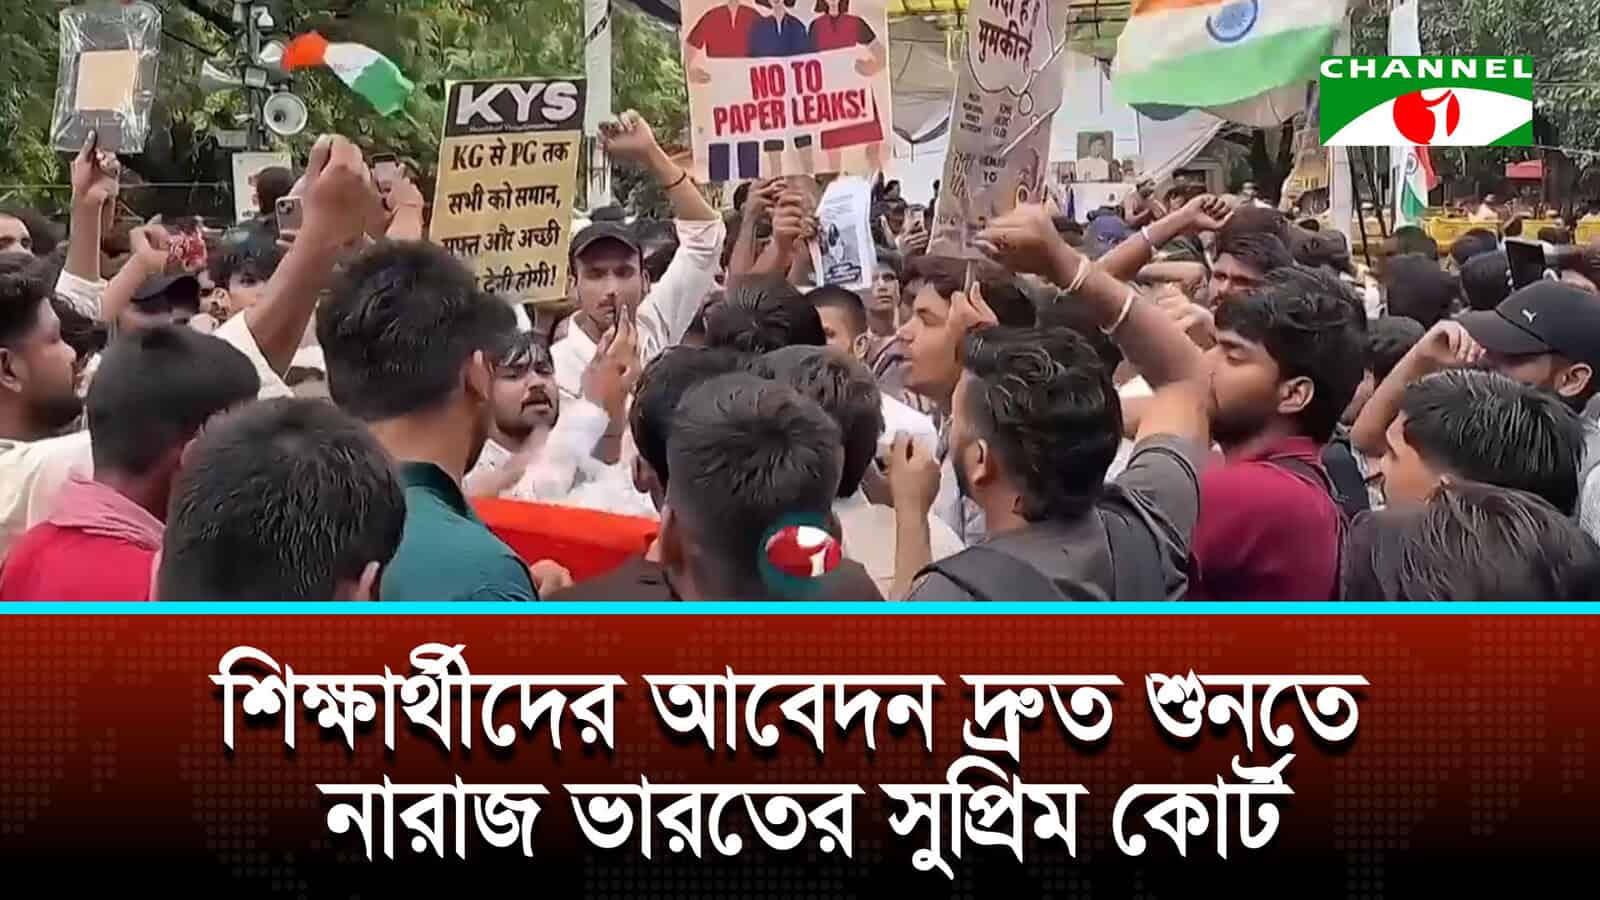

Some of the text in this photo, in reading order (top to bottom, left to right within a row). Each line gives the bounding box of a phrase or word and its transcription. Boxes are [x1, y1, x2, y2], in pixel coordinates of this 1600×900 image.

[750, 59, 823, 100] NO TO
[455, 82, 578, 125] KYS
[713, 89, 868, 136] PAPER LEAKS!
[451, 137, 571, 170] KG से PG तक
[448, 182, 561, 214] सभी को समान,
[483, 224, 515, 251] और
[518, 218, 561, 248] अच्छी
